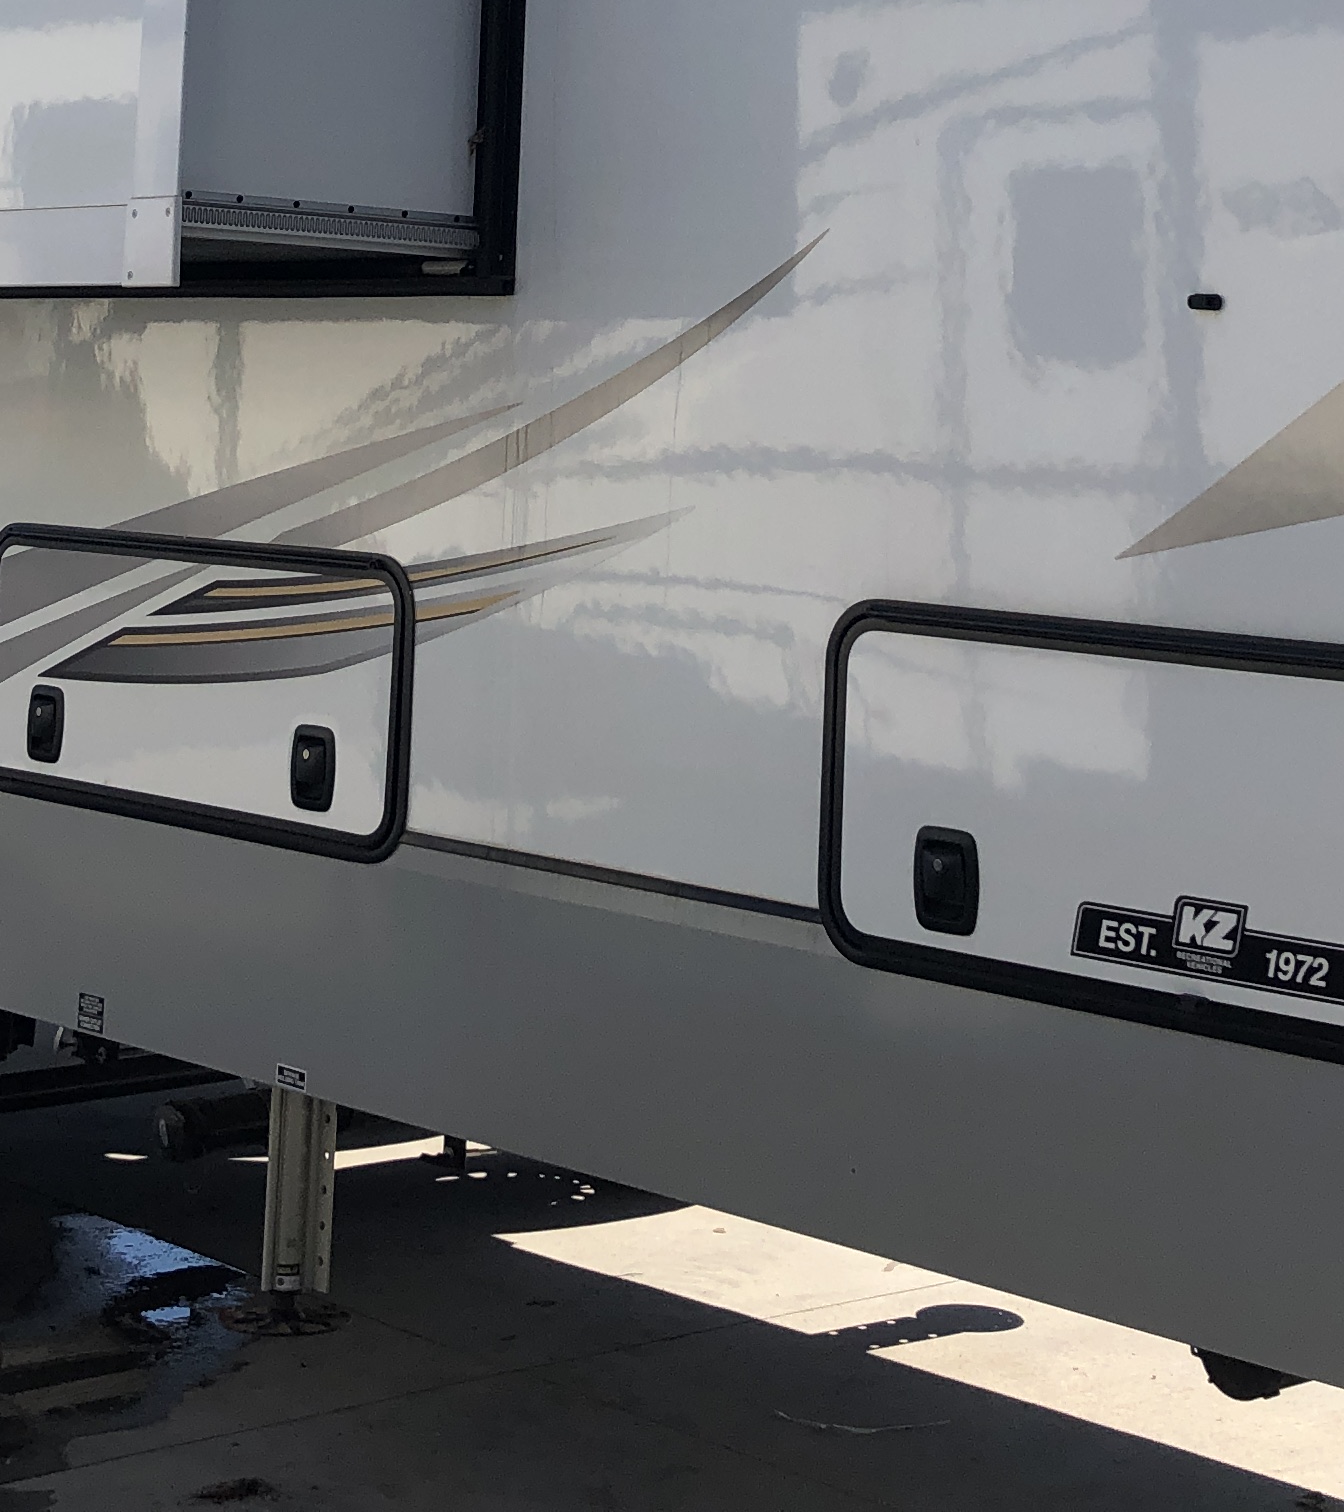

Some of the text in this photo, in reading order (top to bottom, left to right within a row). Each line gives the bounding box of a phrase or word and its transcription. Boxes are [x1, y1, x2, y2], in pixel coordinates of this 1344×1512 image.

[1098, 919, 1329, 988] EST. 1972
[1179, 905, 1238, 951] KZ
